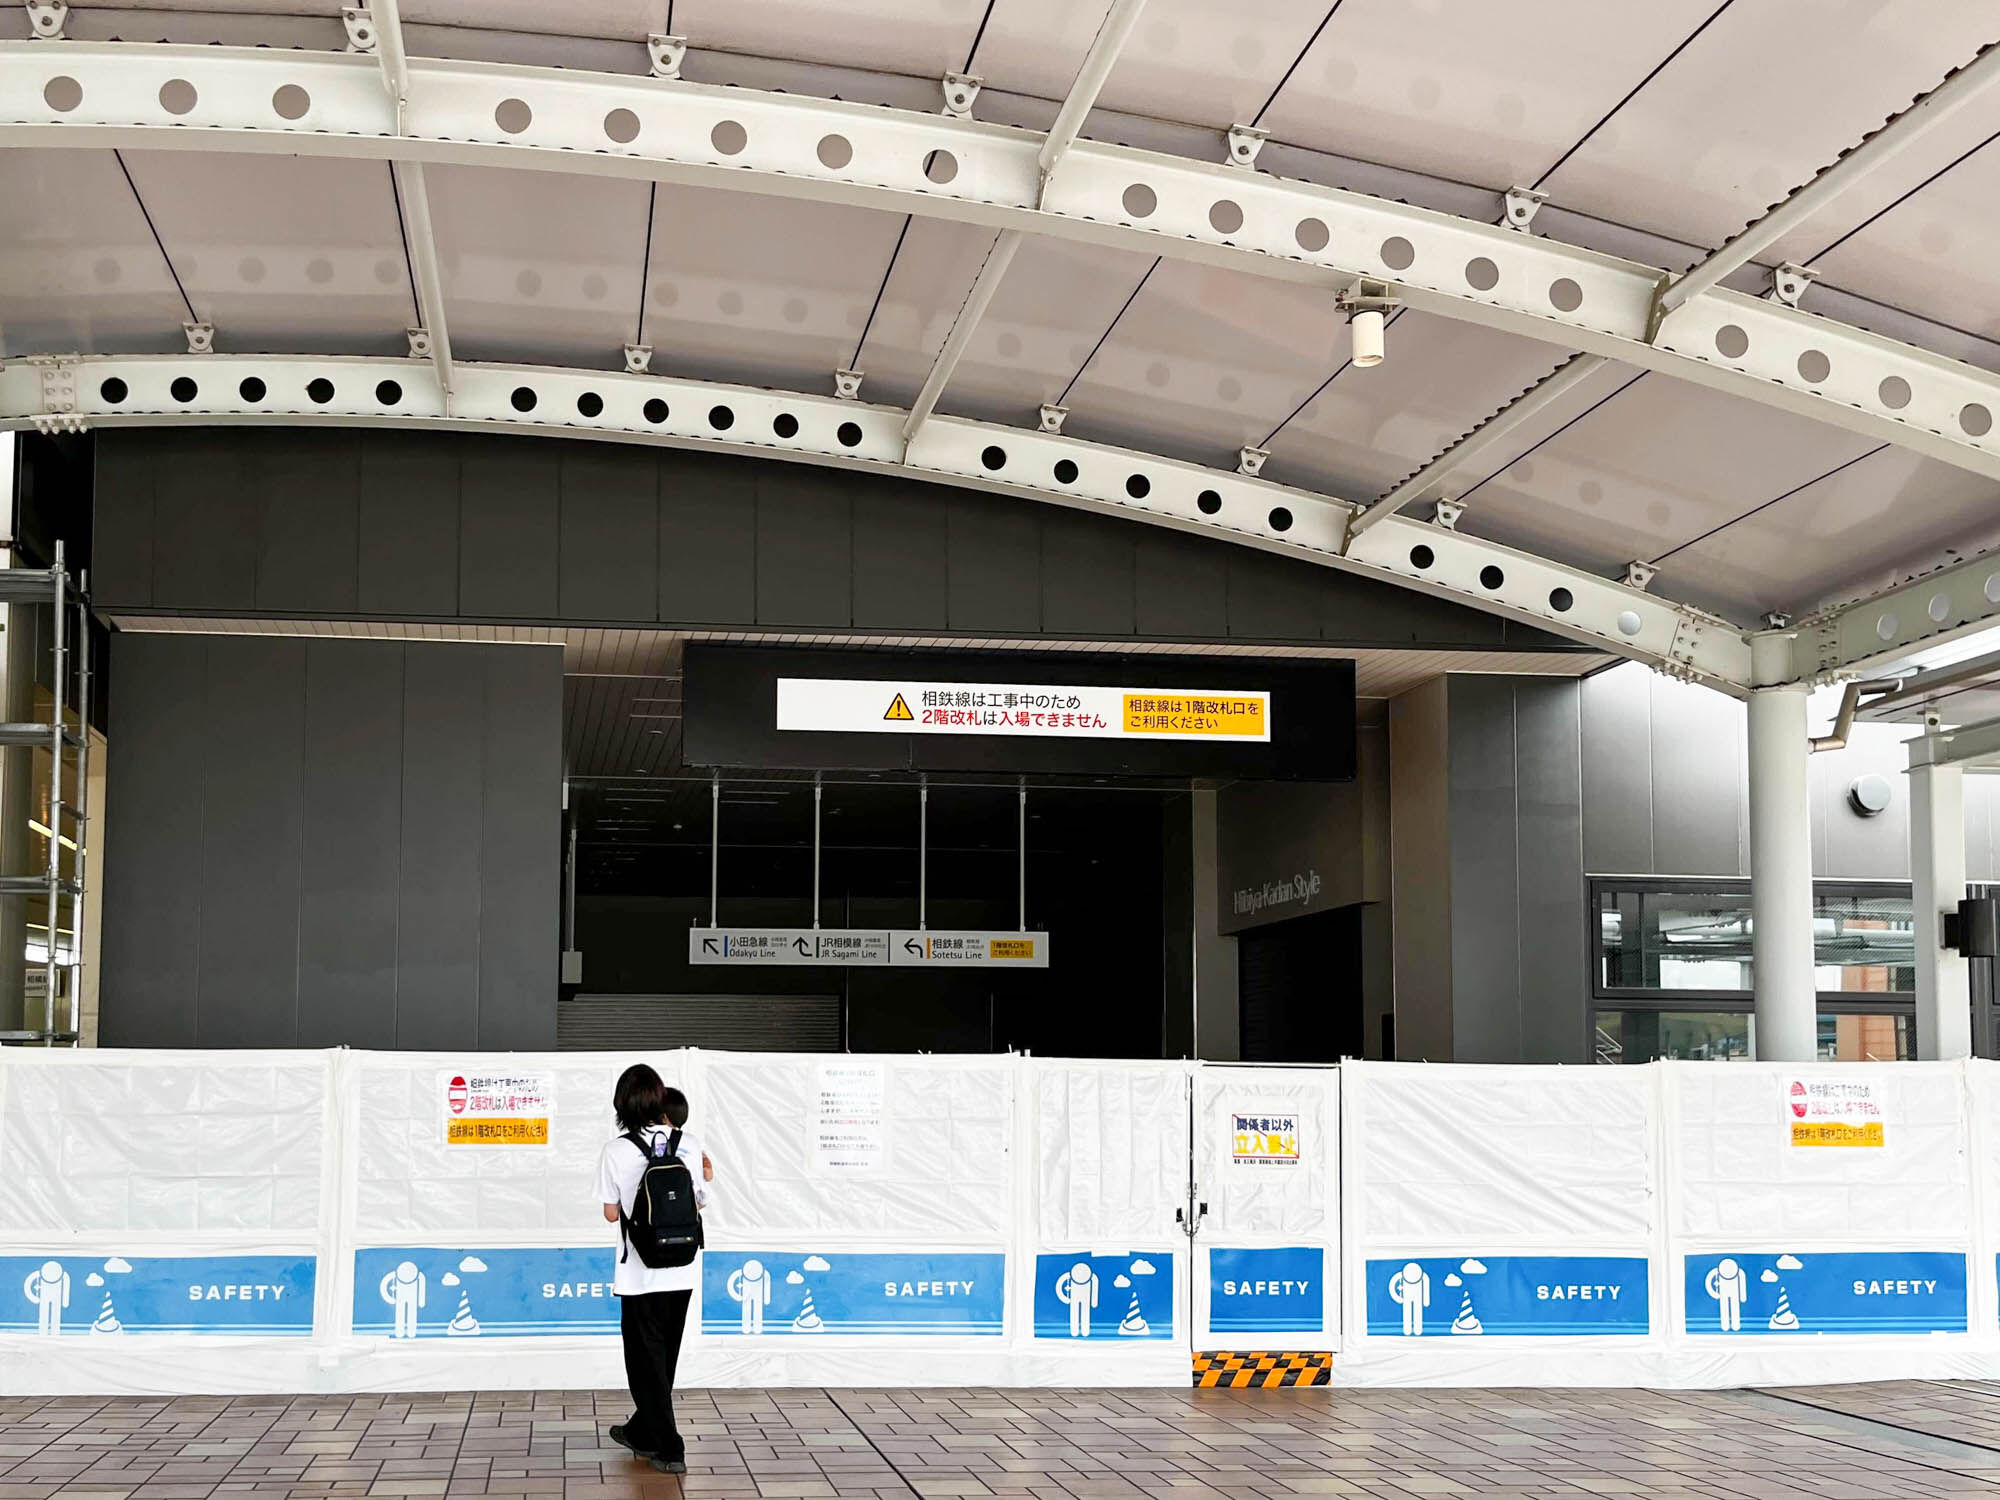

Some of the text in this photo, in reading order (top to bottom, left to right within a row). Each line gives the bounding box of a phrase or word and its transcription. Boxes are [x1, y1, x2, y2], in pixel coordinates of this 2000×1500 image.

[921, 690, 1081, 710] 相鉄線は工事中のため
[1128, 698, 1259, 715] 相鉄線は1階改札口を
[921, 709, 1107, 729] 2階改札は入場できません
[1129, 715, 1219, 729] ご利用ください
[1294, 869, 1320, 905] Style
[729, 936, 768, 947] 小田急線
[821, 937, 861, 948] JR相模線
[932, 938, 963, 949] 相鉄線
[729, 948, 776, 959] Odakyu Line
[821, 949, 877, 960] JR Sagami Line
[932, 950, 983, 960] Sotetsu Line
[1236, 1118, 1294, 1132] 関係者以外
[189, 1285, 285, 1301] SAFETY
[543, 1282, 616, 1298] SAFET
[885, 1281, 974, 1297] SAFETY
[1223, 1281, 1308, 1295] SAFETY
[1537, 1285, 1621, 1299] SAFETY
[1853, 1280, 1937, 1295] SAFETY
